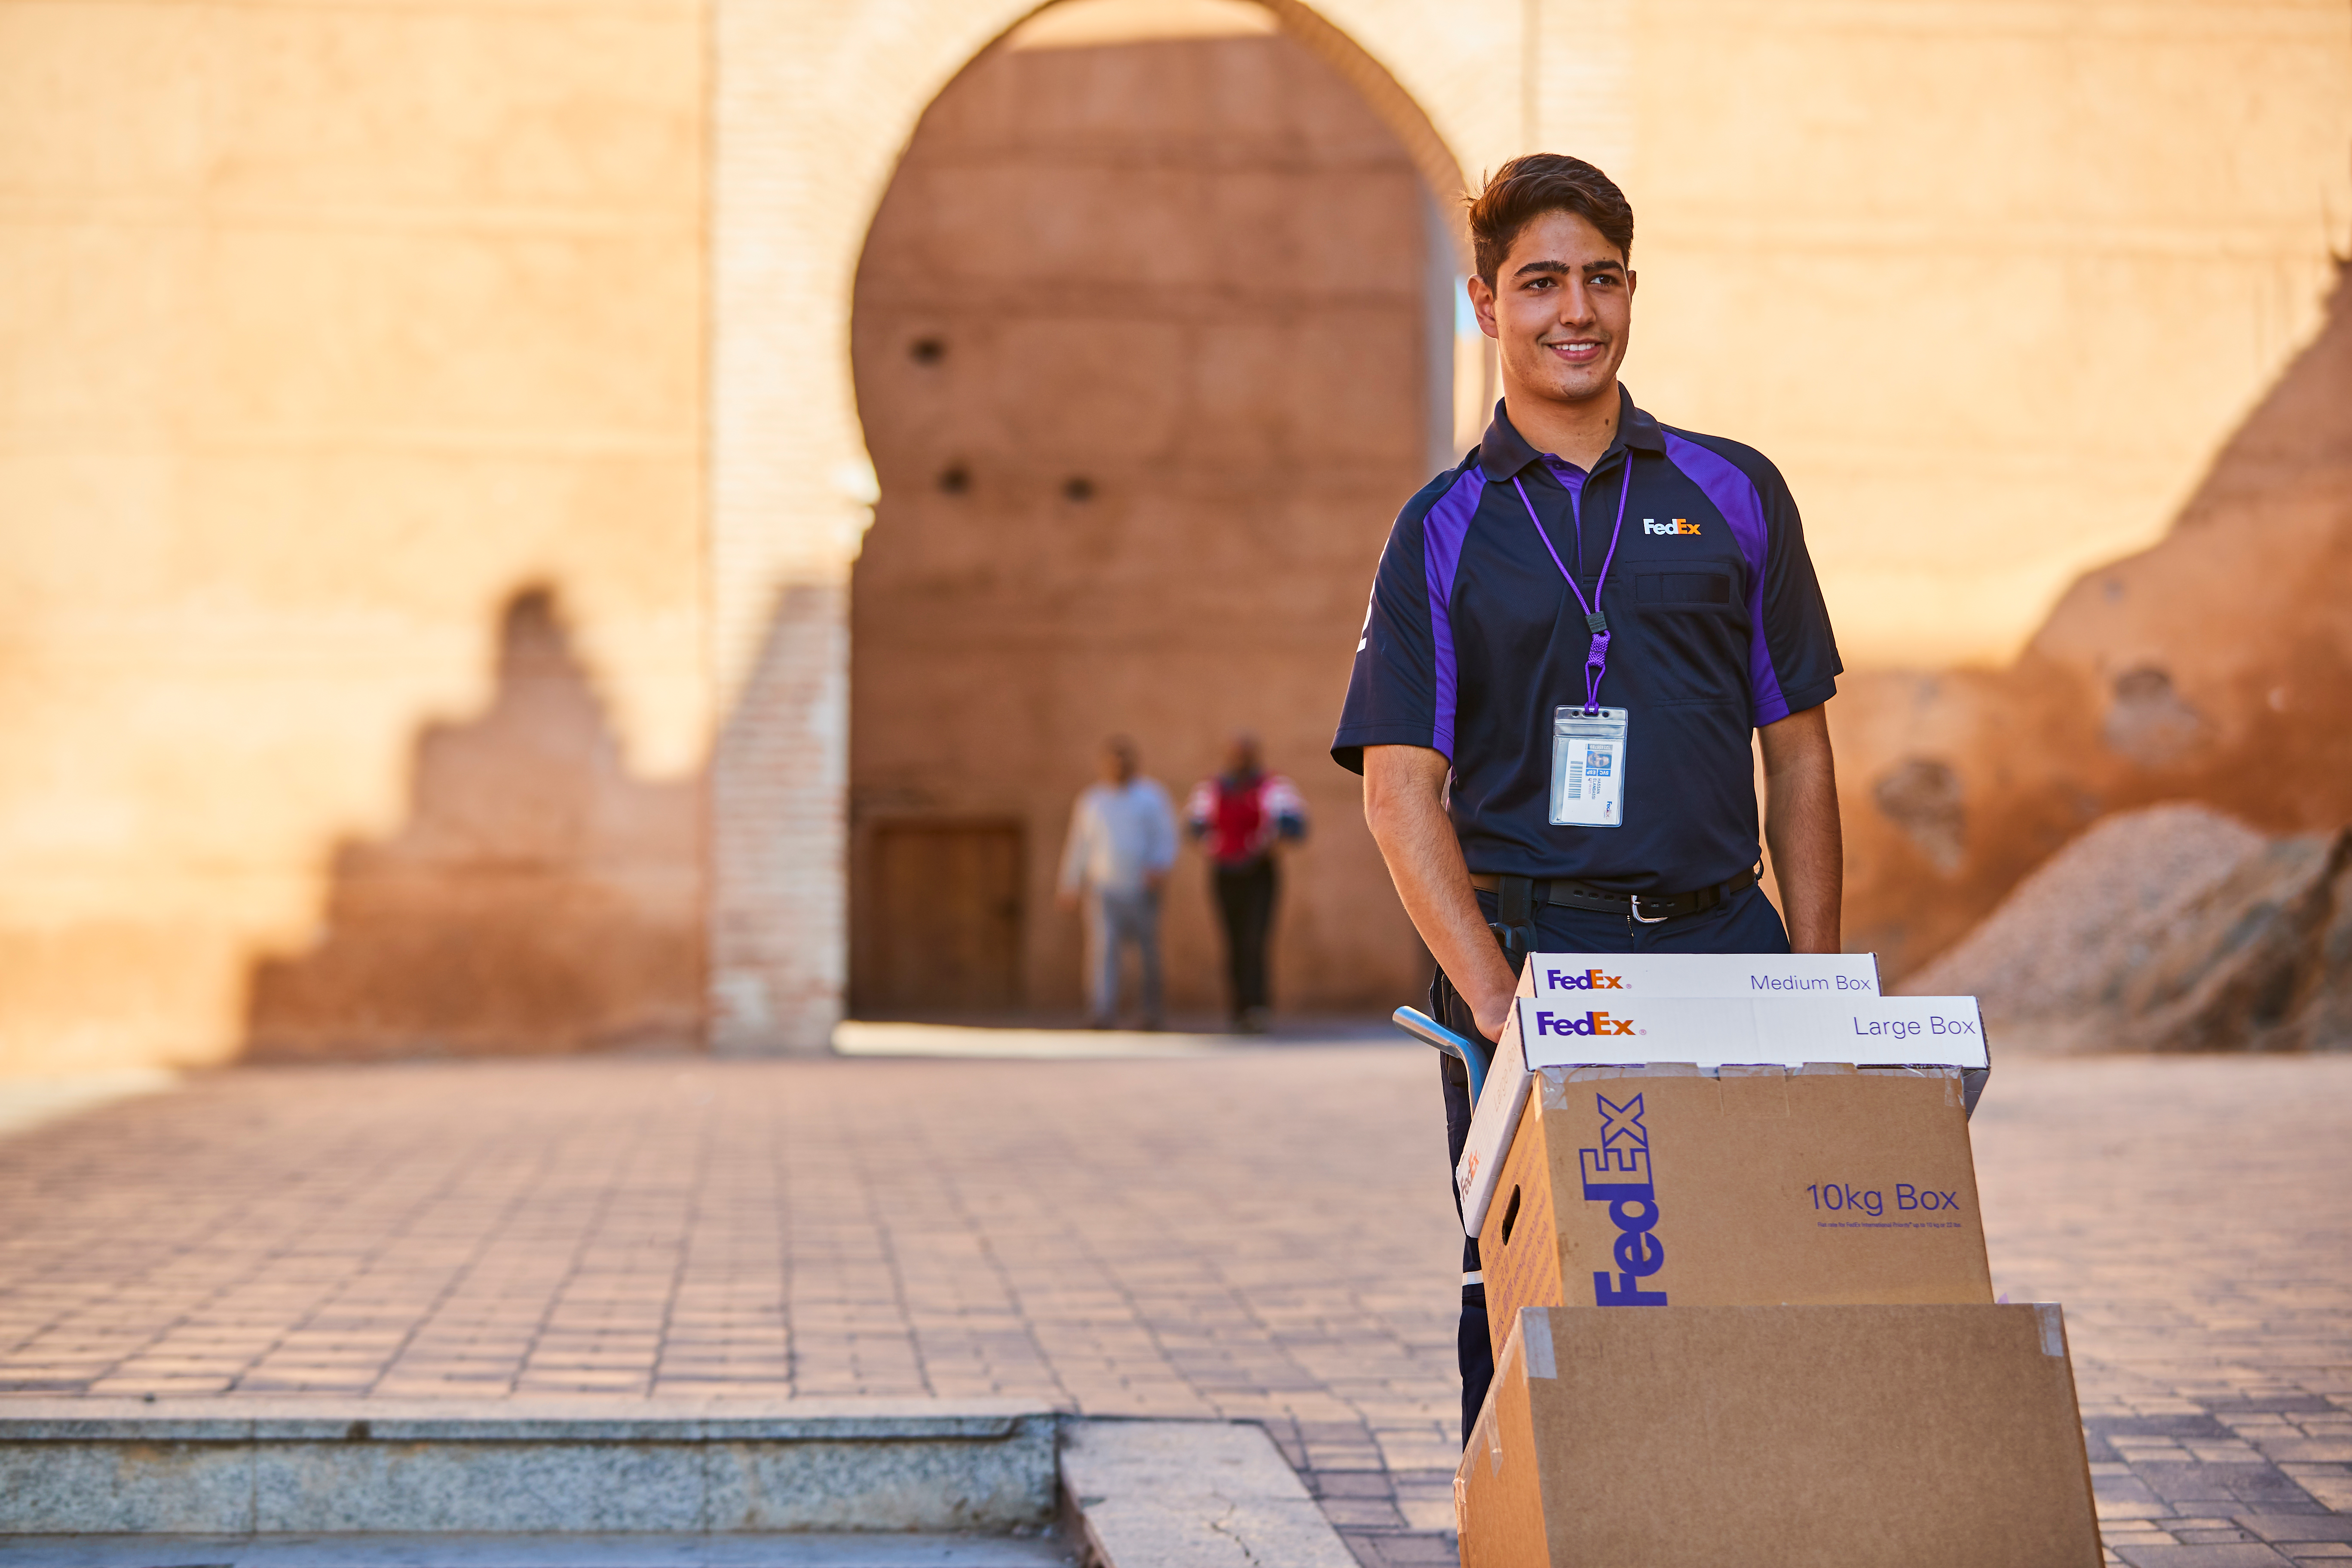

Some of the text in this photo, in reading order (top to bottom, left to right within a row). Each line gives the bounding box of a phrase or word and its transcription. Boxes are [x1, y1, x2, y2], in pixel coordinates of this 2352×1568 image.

[1643, 518, 1701, 535] FedEx
[1547, 969, 1623, 989] FedEx
[1751, 975, 1871, 989] Medium Box
[1537, 1011, 1636, 1035] FedEx
[1854, 1016, 1976, 1039] Large Box
[1493, 1069, 1508, 1112] Large
[1461, 1149, 1479, 1203] FedEx
[1579, 1092, 1667, 1306] FedEx
[1807, 1183, 1960, 1216] 10kg Box
